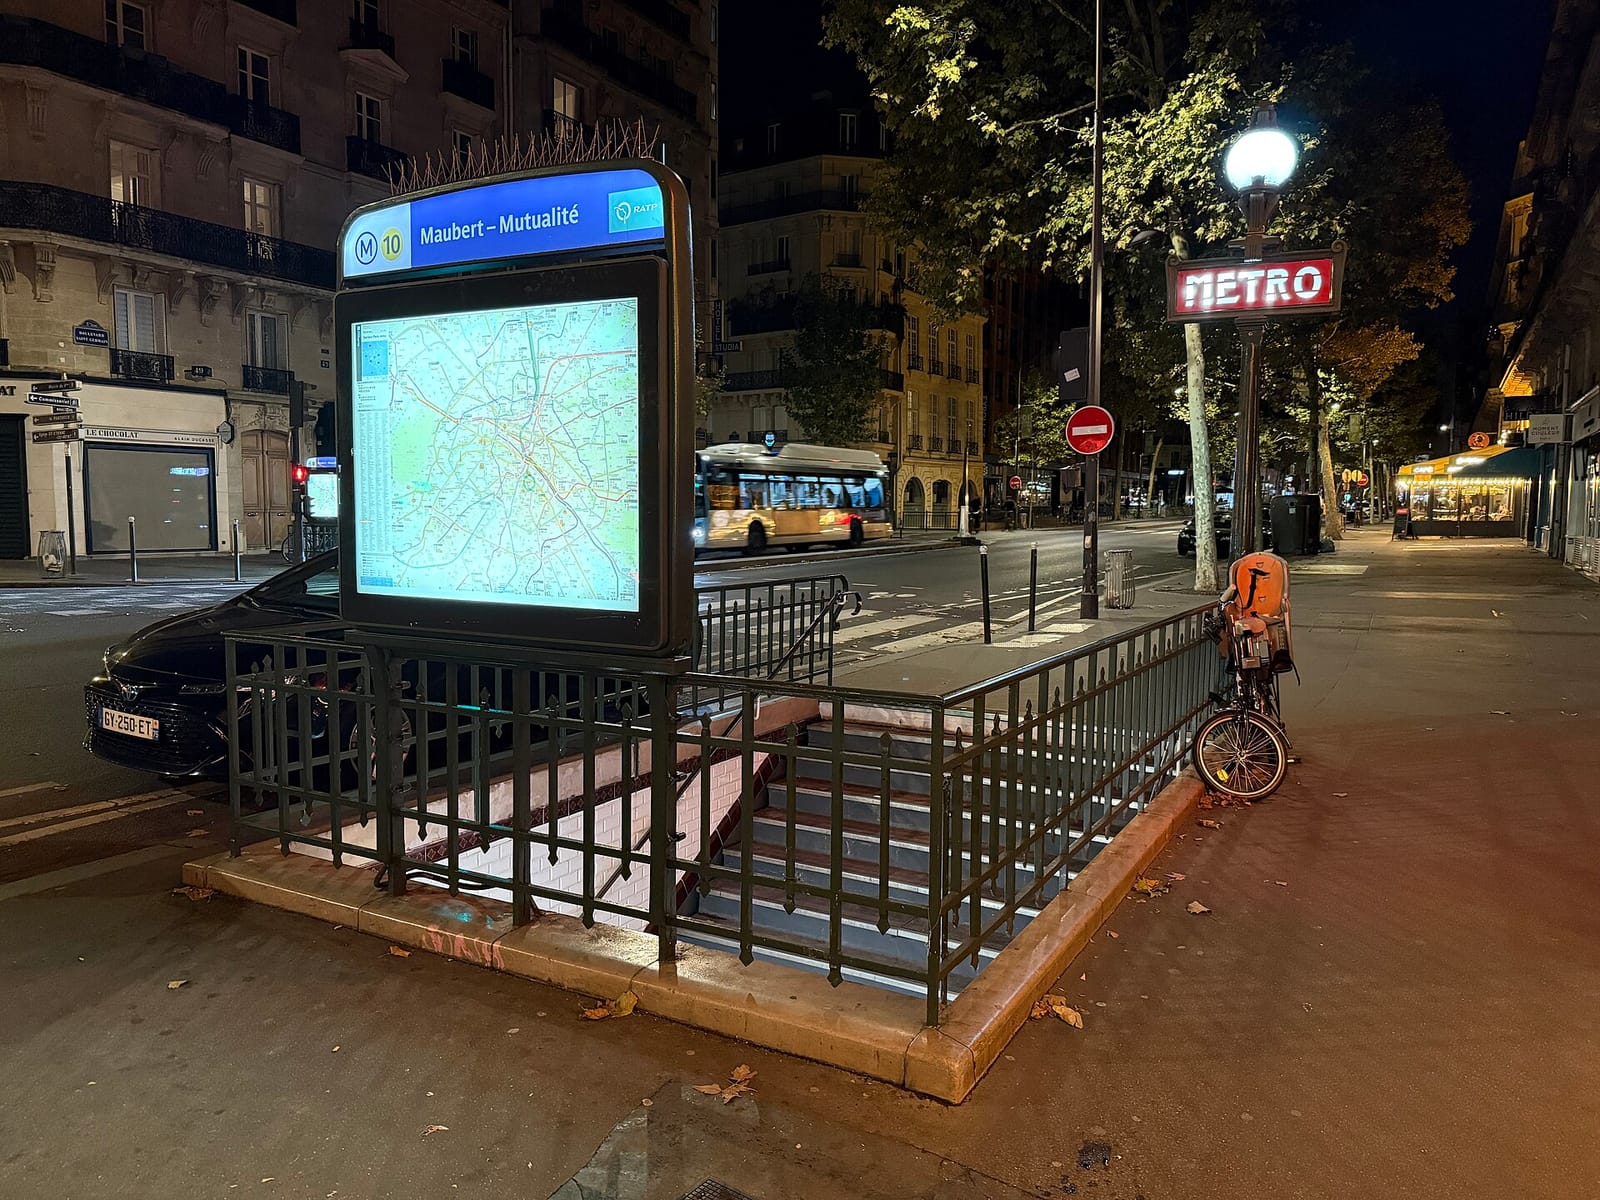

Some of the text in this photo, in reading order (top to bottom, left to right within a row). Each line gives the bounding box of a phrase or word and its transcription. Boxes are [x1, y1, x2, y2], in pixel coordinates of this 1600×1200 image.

[633, 203, 658, 213] RATP
[383, 234, 401, 255] 10
[420, 219, 484, 245] Maubert
[499, 203, 579, 234] Mutualité
[1184, 266, 1322, 307] METRO
[86, 429, 139, 438] LE CHOCOLAT
[105, 711, 151, 736] GY-250-ET
